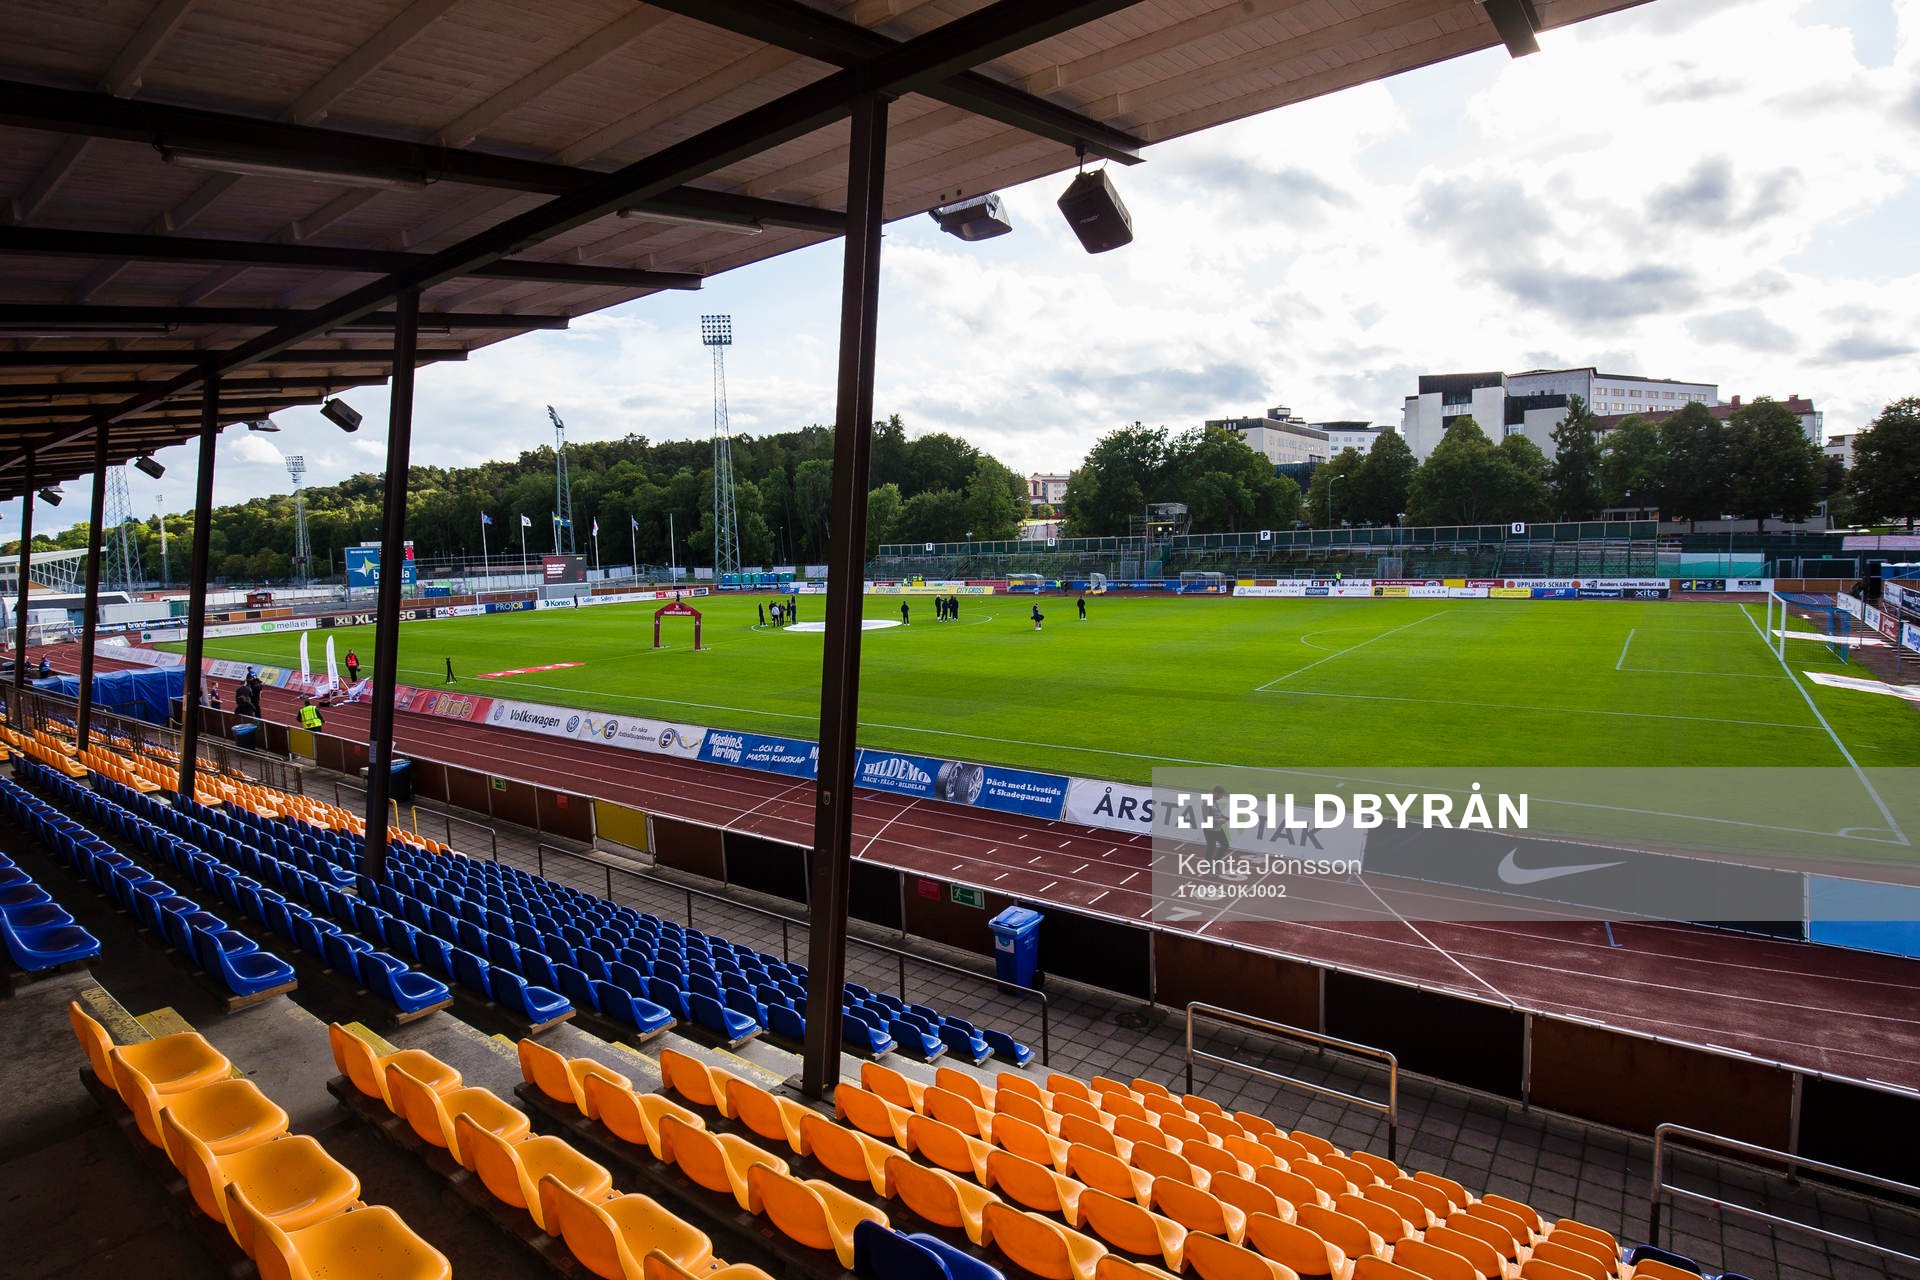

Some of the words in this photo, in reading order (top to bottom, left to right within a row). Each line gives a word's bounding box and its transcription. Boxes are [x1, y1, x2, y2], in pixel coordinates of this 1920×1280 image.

[1635, 589, 1659, 597] xite
[495, 602, 523, 611] PROJOB
[510, 709, 560, 728] Volkswagen
[711, 745, 741, 762] Verktyg
[775, 745, 785, 753] EN
[746, 753, 770, 762] MASSA
[771, 755, 806, 764] KUNSKAP
[864, 757, 931, 783] BILDEMO
[862, 775, 878, 783] DÄCK
[986, 777, 1007, 787] Däck
[1008, 782, 1026, 790] med
[1027, 783, 1061, 796] Livstids
[996, 788, 1052, 804] Skadegaranti
